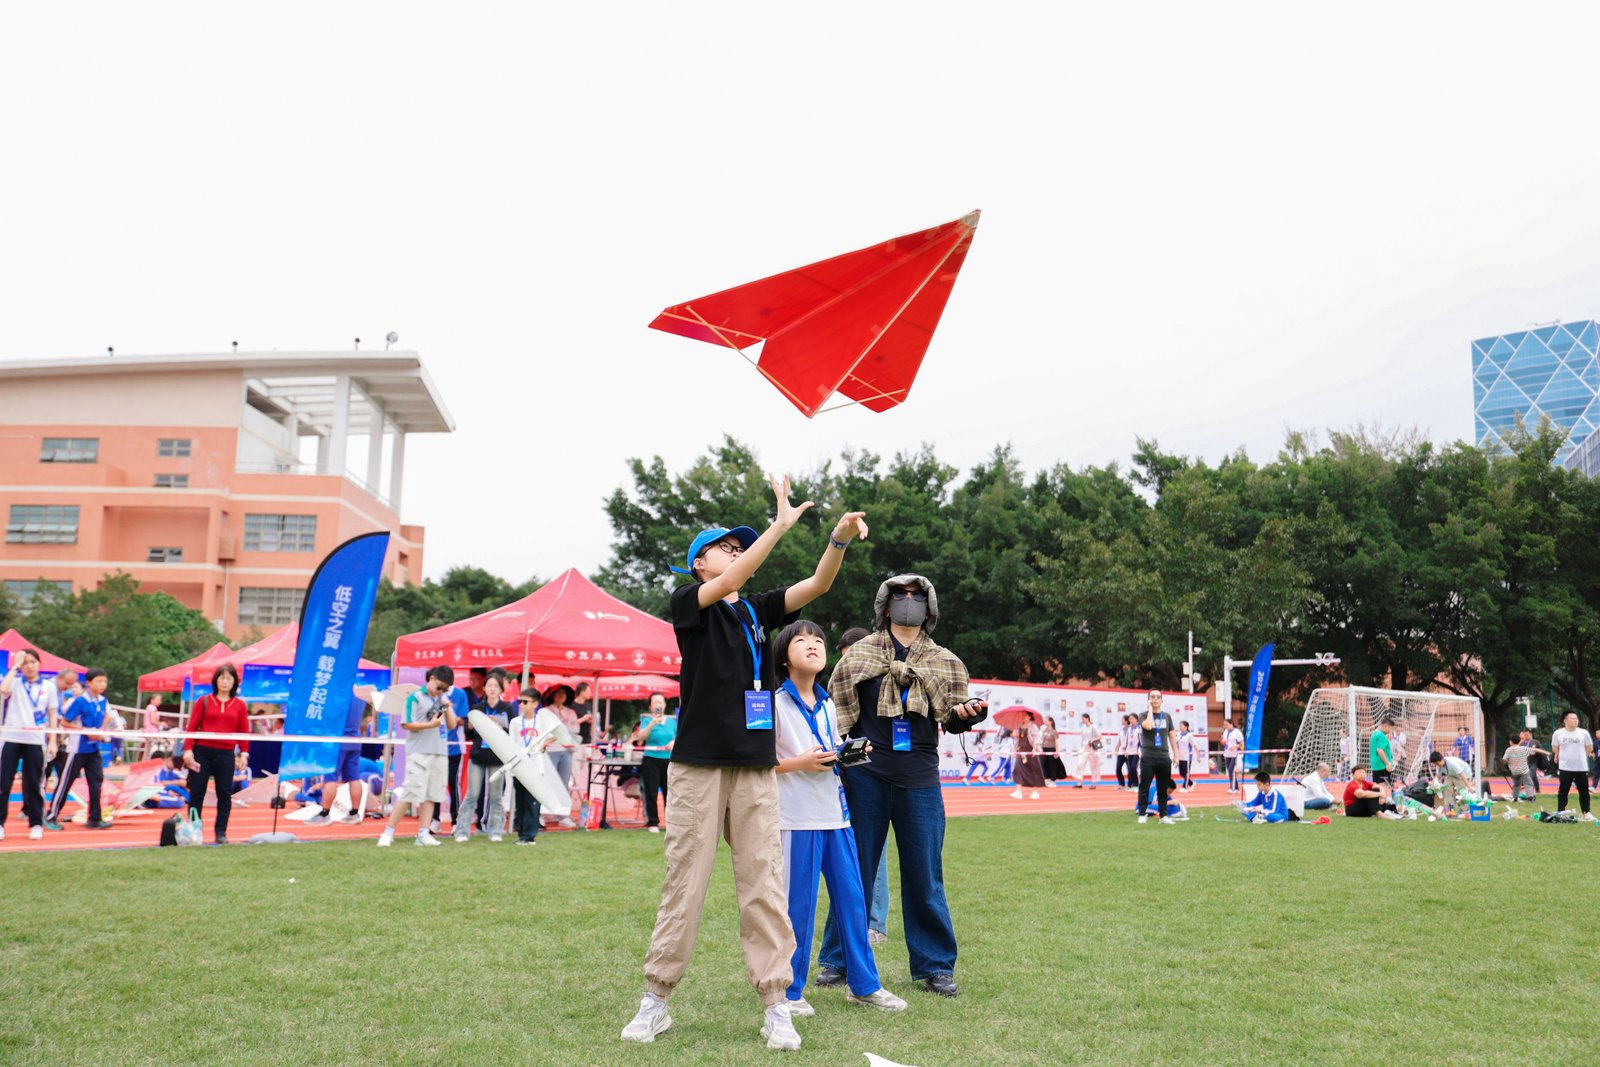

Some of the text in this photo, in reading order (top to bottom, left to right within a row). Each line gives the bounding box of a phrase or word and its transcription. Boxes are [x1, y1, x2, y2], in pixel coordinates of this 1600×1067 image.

[306, 585, 352, 720] 低空之翼 载梦起航
